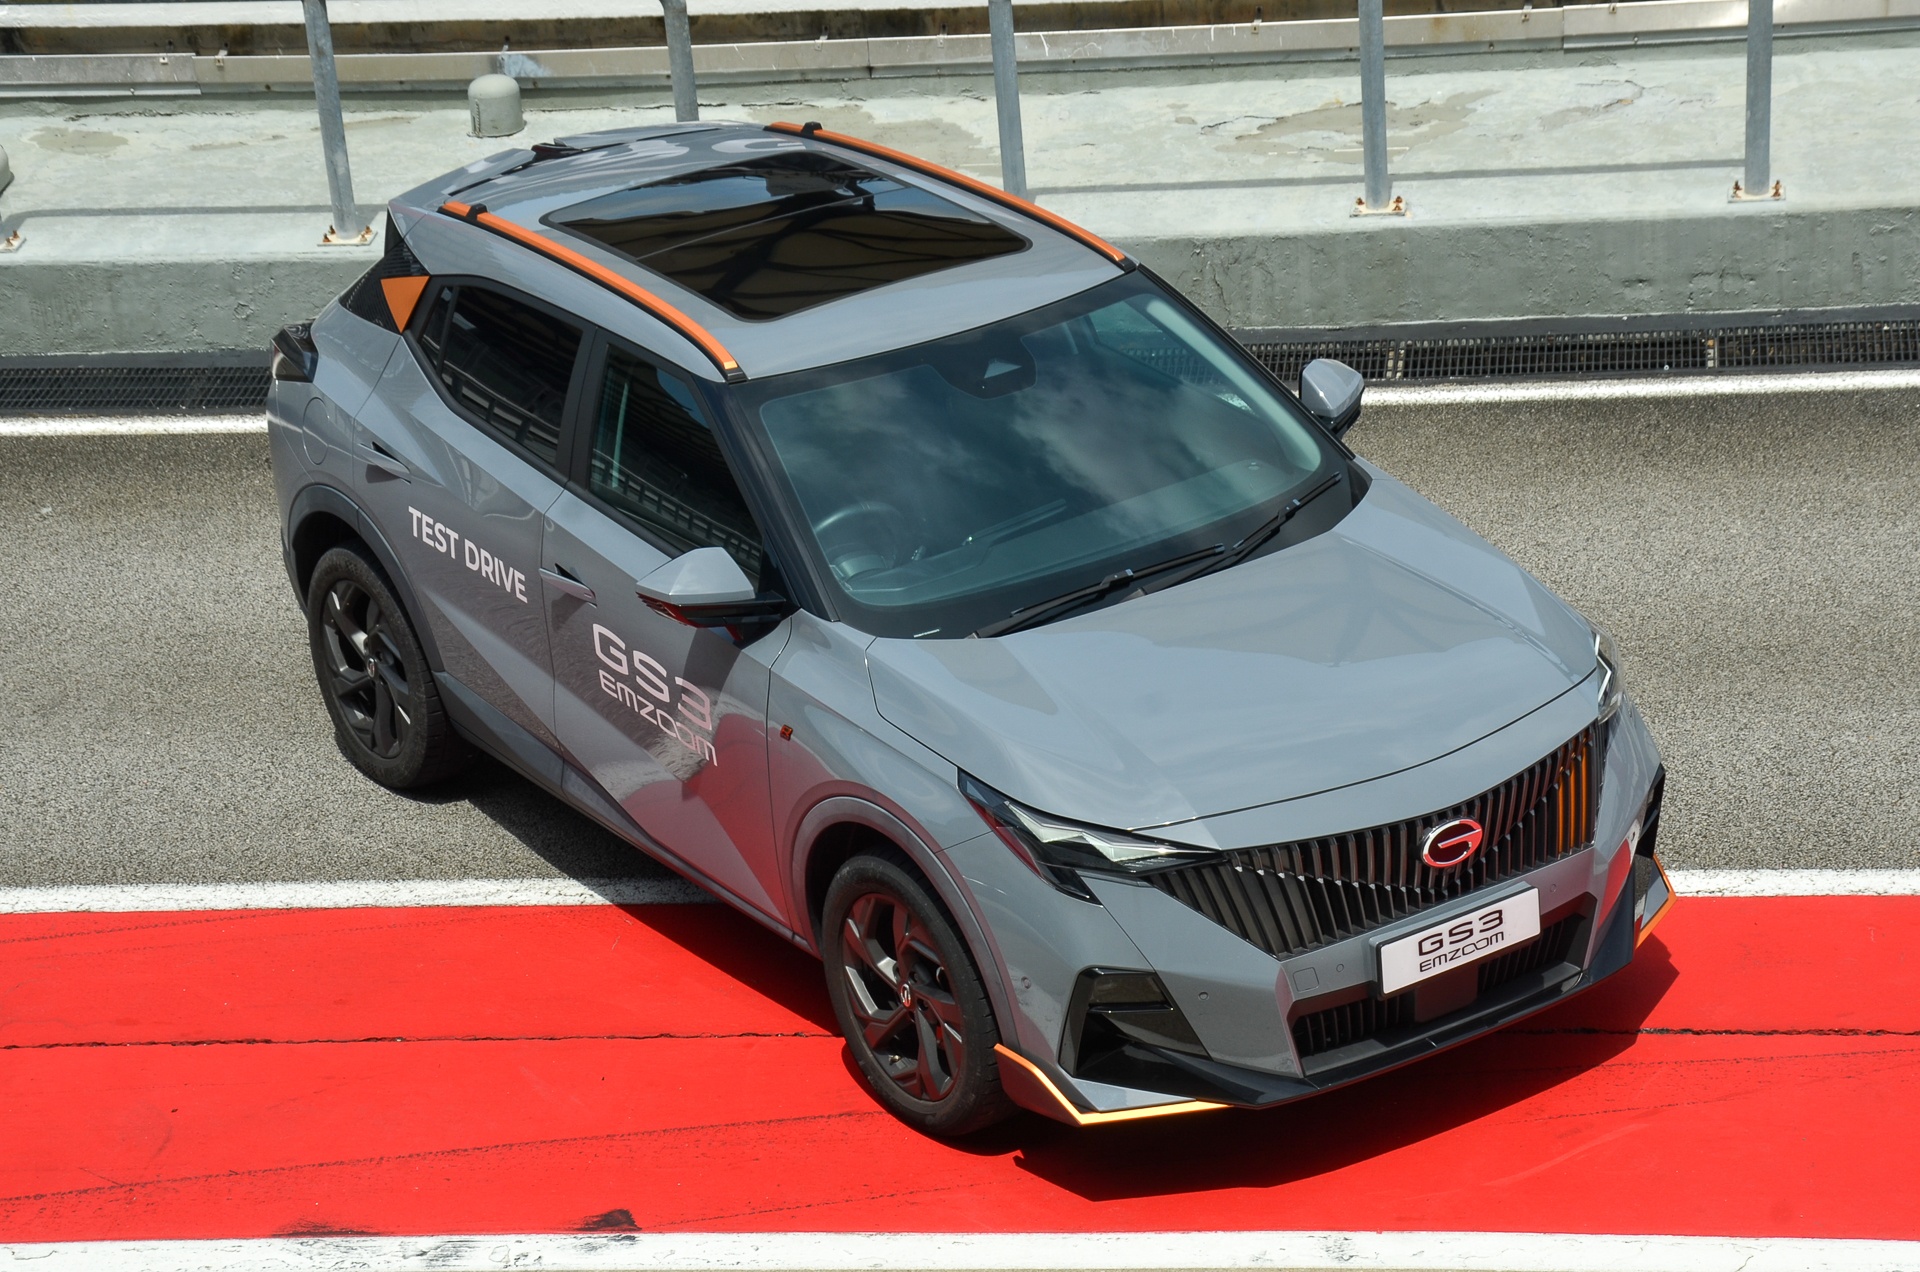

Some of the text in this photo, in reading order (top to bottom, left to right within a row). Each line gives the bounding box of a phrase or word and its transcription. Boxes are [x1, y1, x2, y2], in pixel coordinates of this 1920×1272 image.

[408, 505, 528, 604] TEST DRIVE
[592, 623, 712, 731] GS3
[598, 669, 718, 767] EMZOOM
[1418, 909, 1503, 957] GS3
[1419, 931, 1504, 972] EMZOOM
